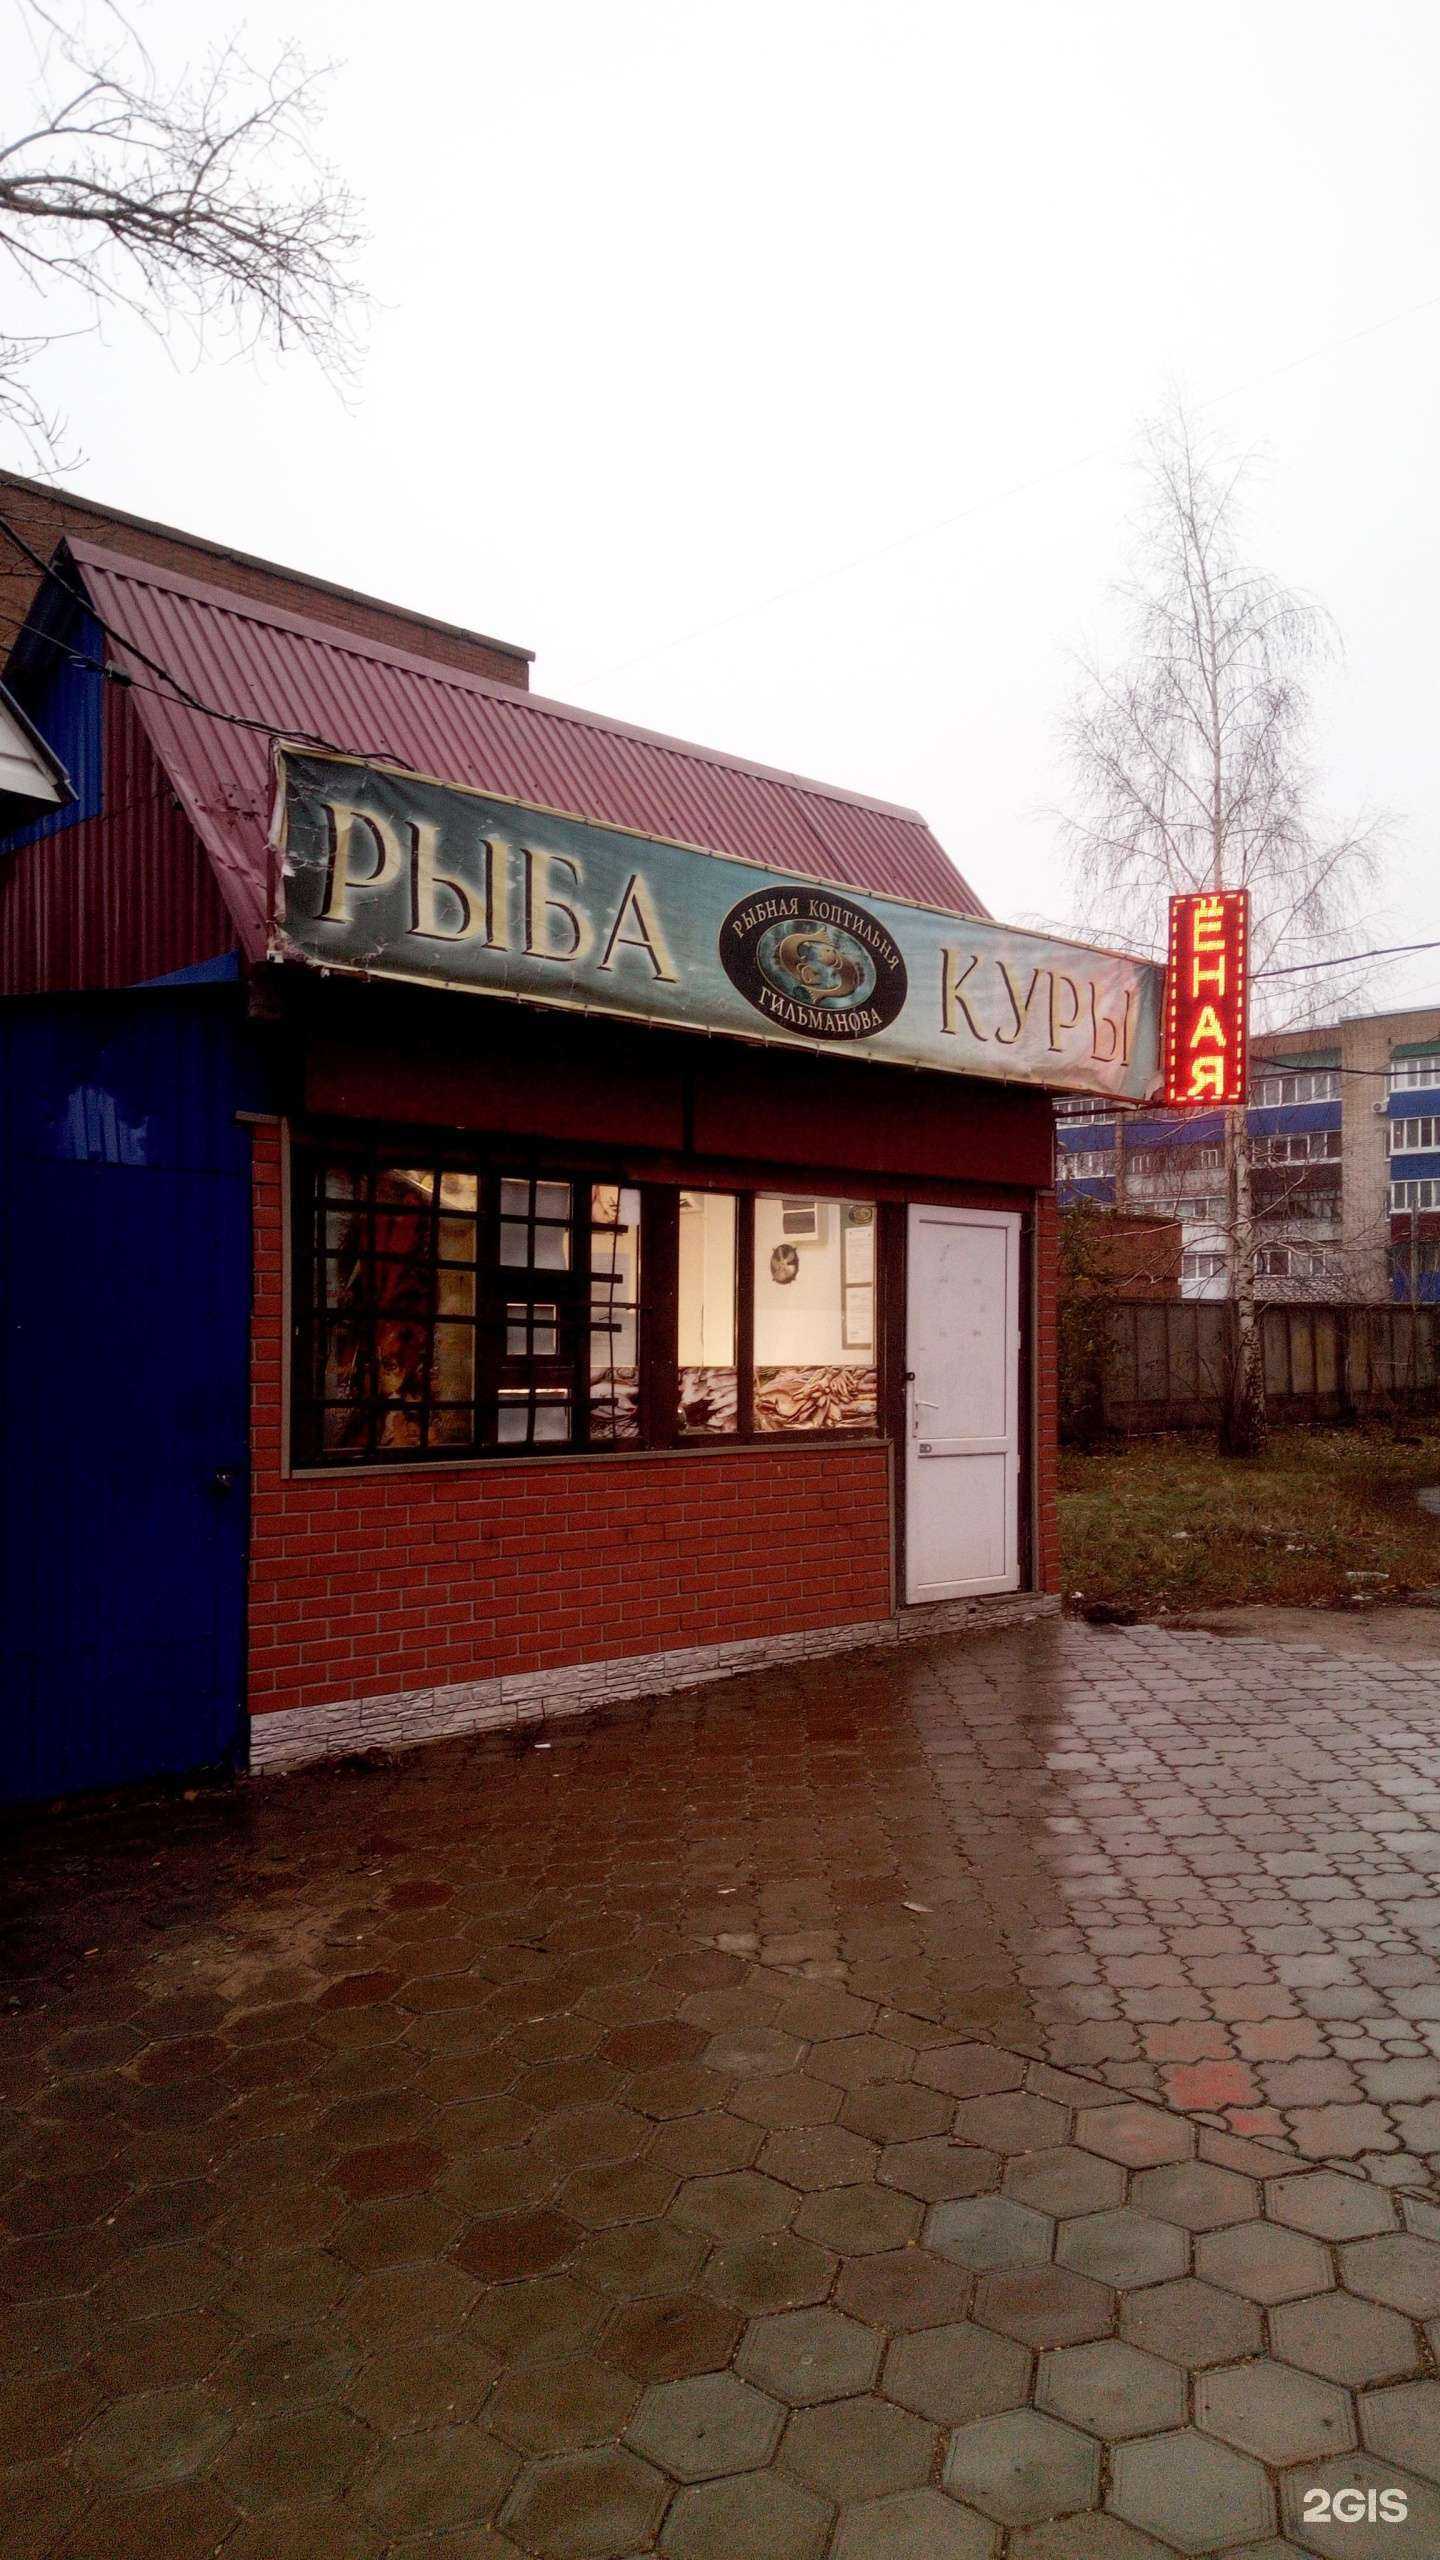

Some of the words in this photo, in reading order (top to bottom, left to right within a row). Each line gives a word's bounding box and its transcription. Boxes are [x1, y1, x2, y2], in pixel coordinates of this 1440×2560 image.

[312, 802, 682, 984] РЫБА
[732, 897, 800, 939] РЫБНАЯ
[808, 899, 900, 971] КОПТИЛЬНЯ
[758, 986, 883, 1032] ГИЛЬМАНОВА
[938, 946, 1134, 1067] КУРЫ
